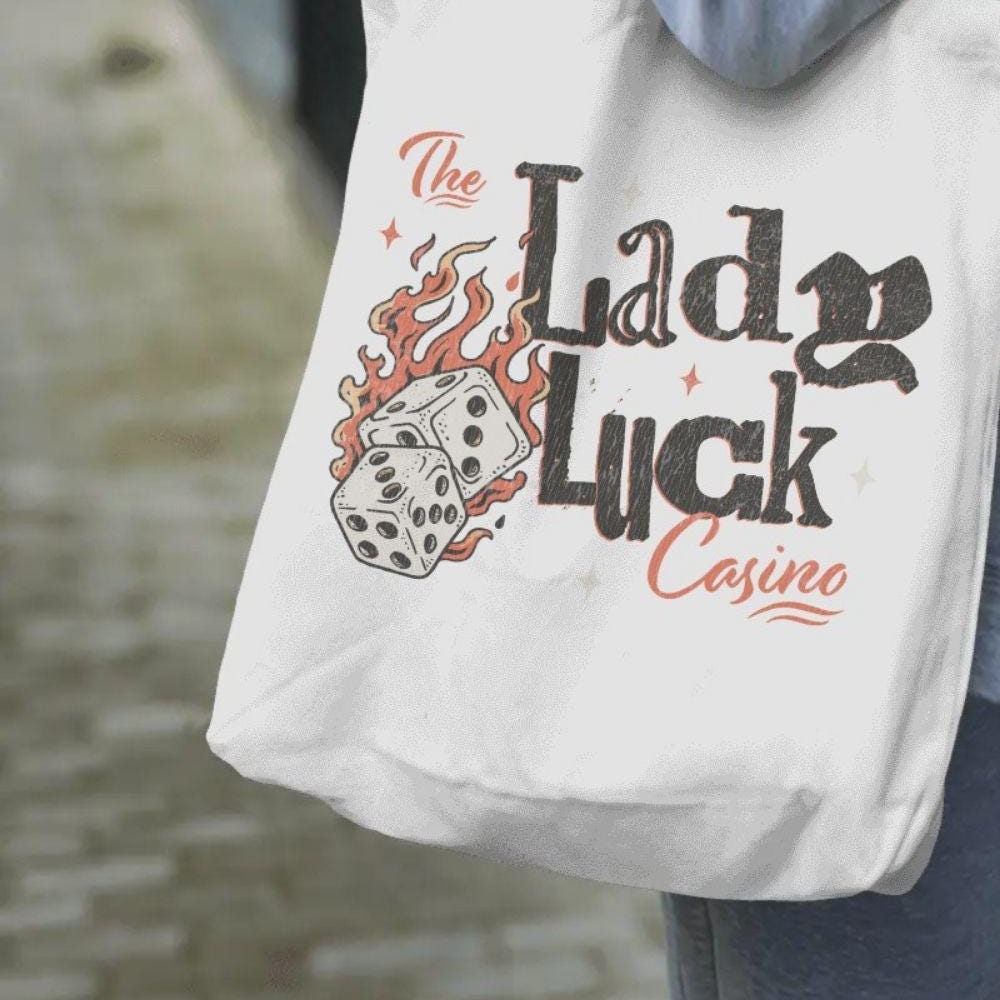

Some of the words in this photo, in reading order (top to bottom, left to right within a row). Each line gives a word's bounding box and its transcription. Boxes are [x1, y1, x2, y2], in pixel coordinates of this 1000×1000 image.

[399, 130, 487, 198] The
[515, 161, 933, 395] Lady
[537, 351, 838, 541] Luck
[646, 513, 849, 604] Casino
